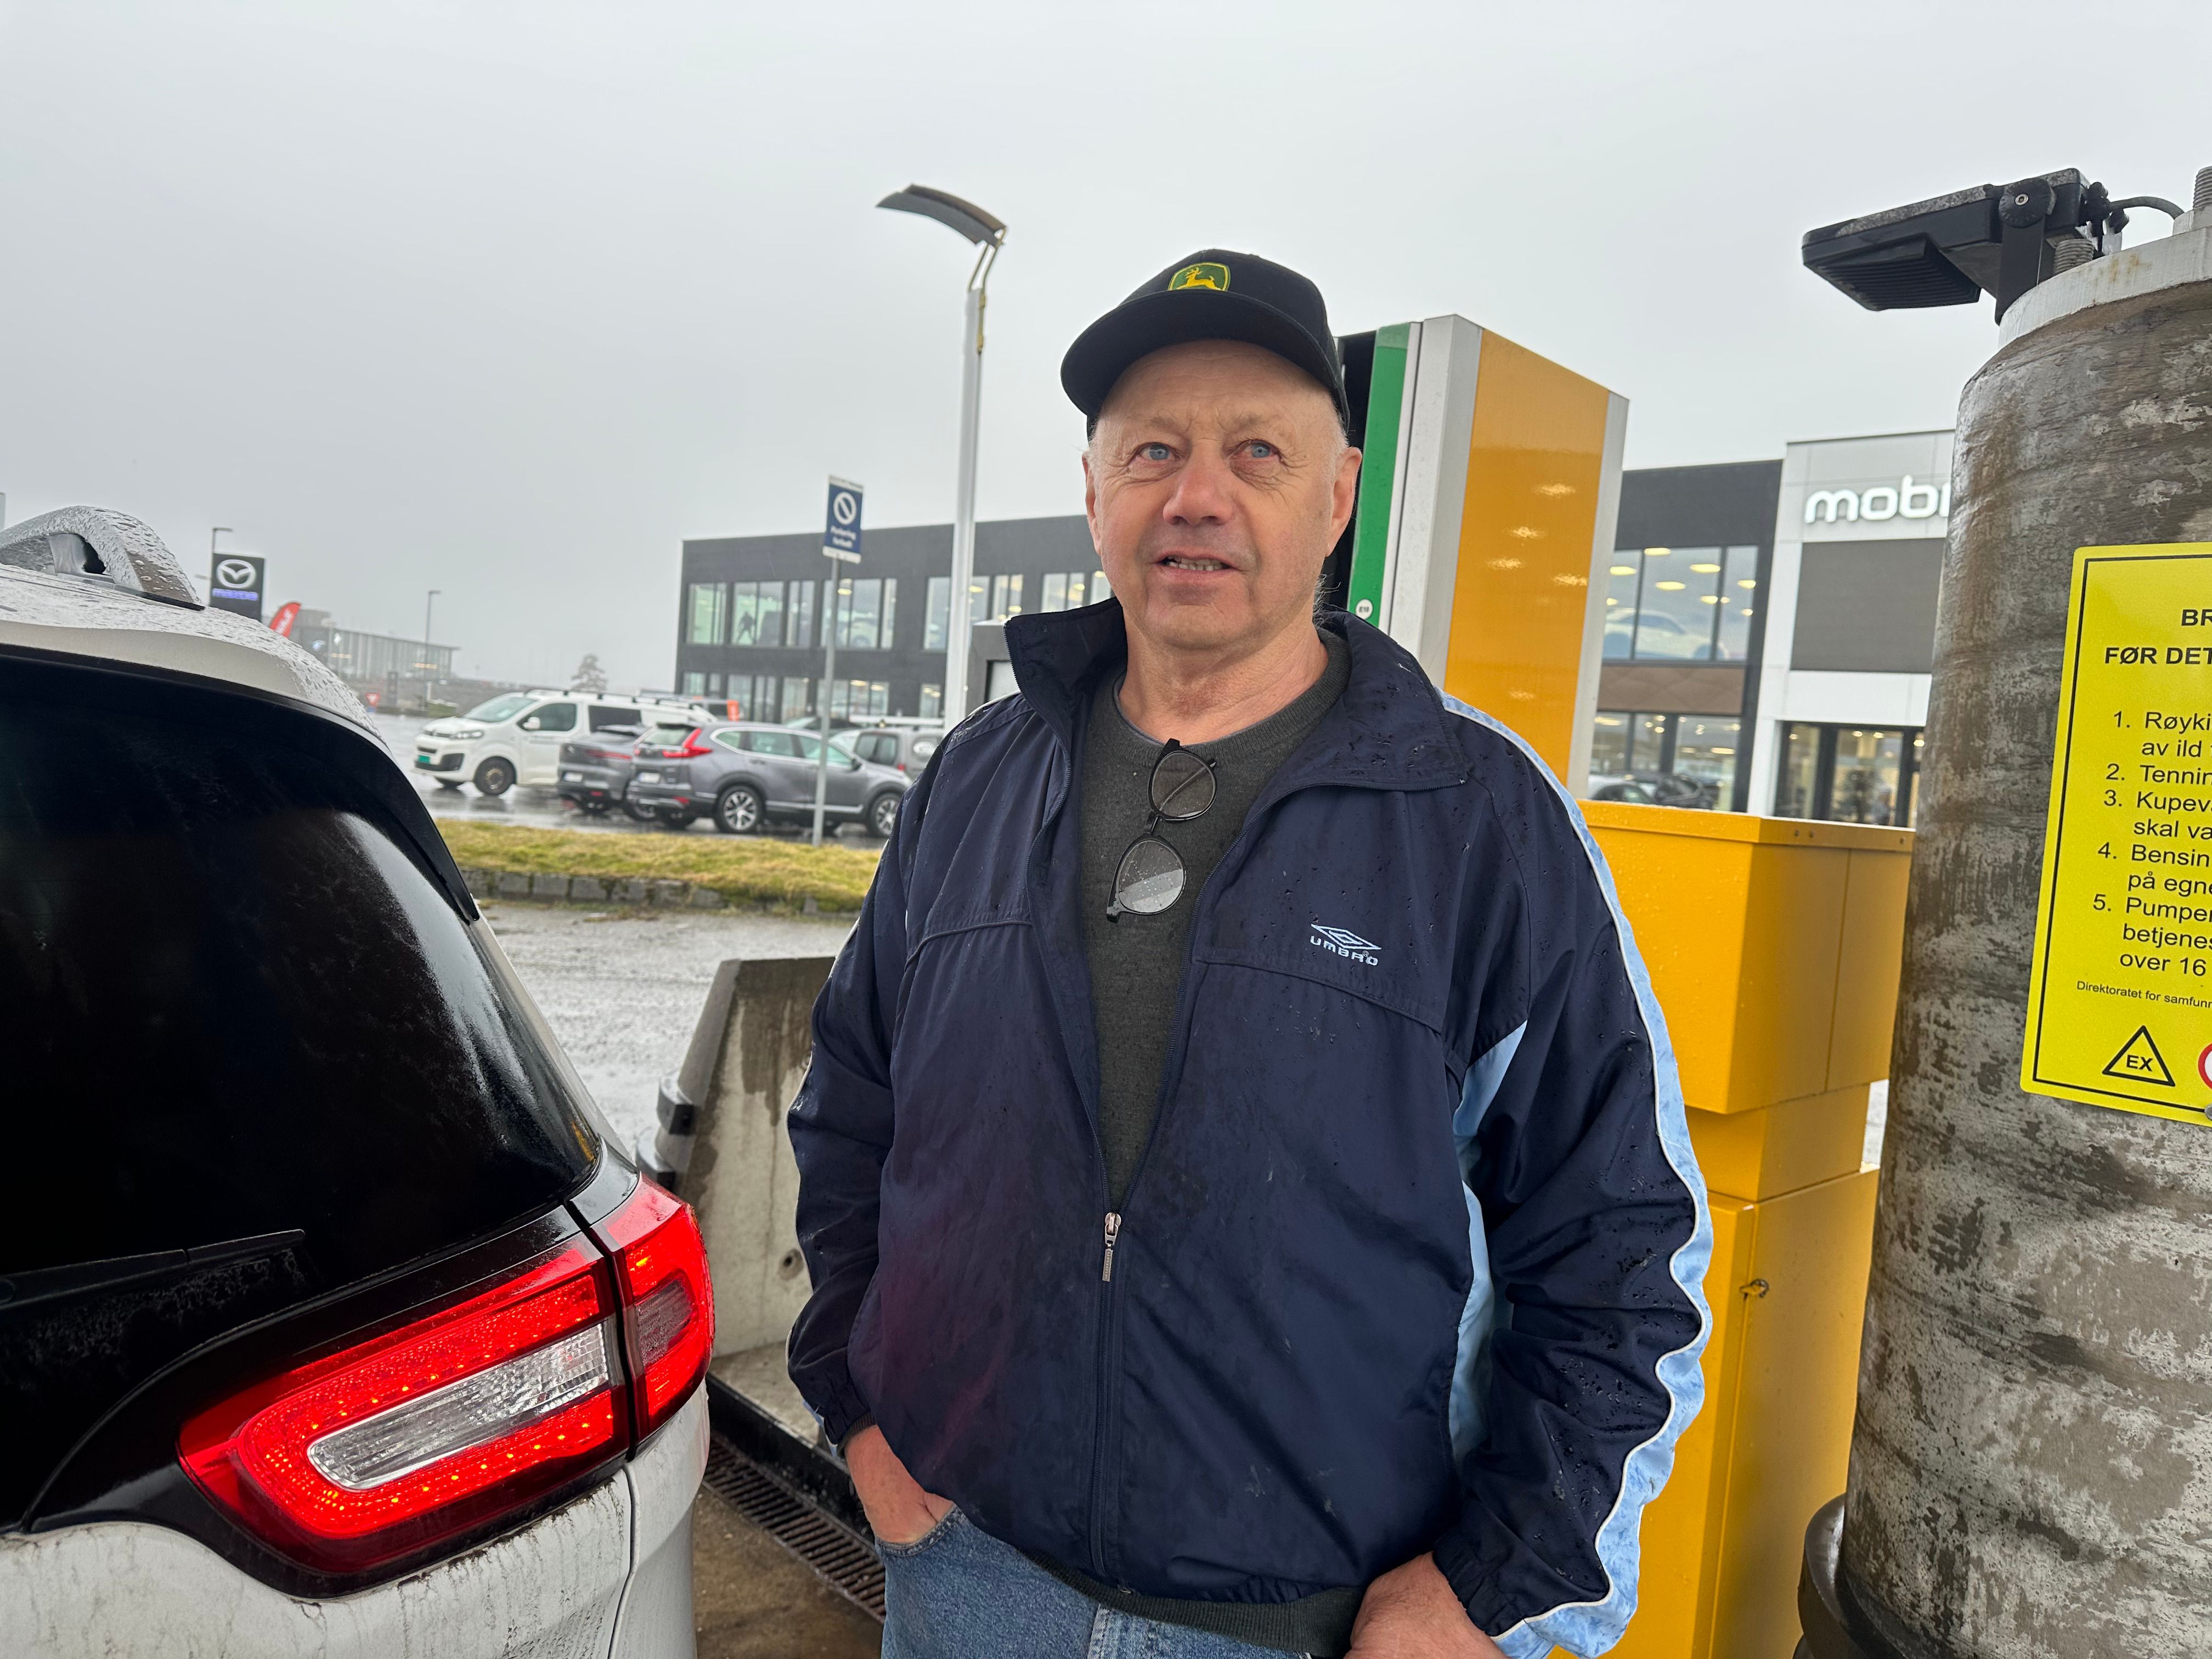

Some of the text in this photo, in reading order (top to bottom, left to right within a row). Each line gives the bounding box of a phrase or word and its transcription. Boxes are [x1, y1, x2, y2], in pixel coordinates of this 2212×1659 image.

[2181, 609, 2212, 626] BR
[2104, 647, 2212, 665] FØR DET
[2113, 710, 2212, 734] 1. Røyki
[2141, 742, 2169, 756] av
[2177, 740, 2202, 758] ild
[2106, 763, 2212, 785] 2. Tennin
[2104, 789, 2212, 815] 3. Kupev
[2134, 819, 2212, 840] skal va
[2097, 842, 2210, 867] 4. Bensin
[2128, 871, 2155, 891] på
[2093, 894, 2212, 924] 5. Pumpe
[2120, 953, 2207, 977] over 16
[2077, 981, 2142, 998] Direktoratet
[2145, 990, 2161, 1001] for
[2126, 1054, 2153, 1072] EX
